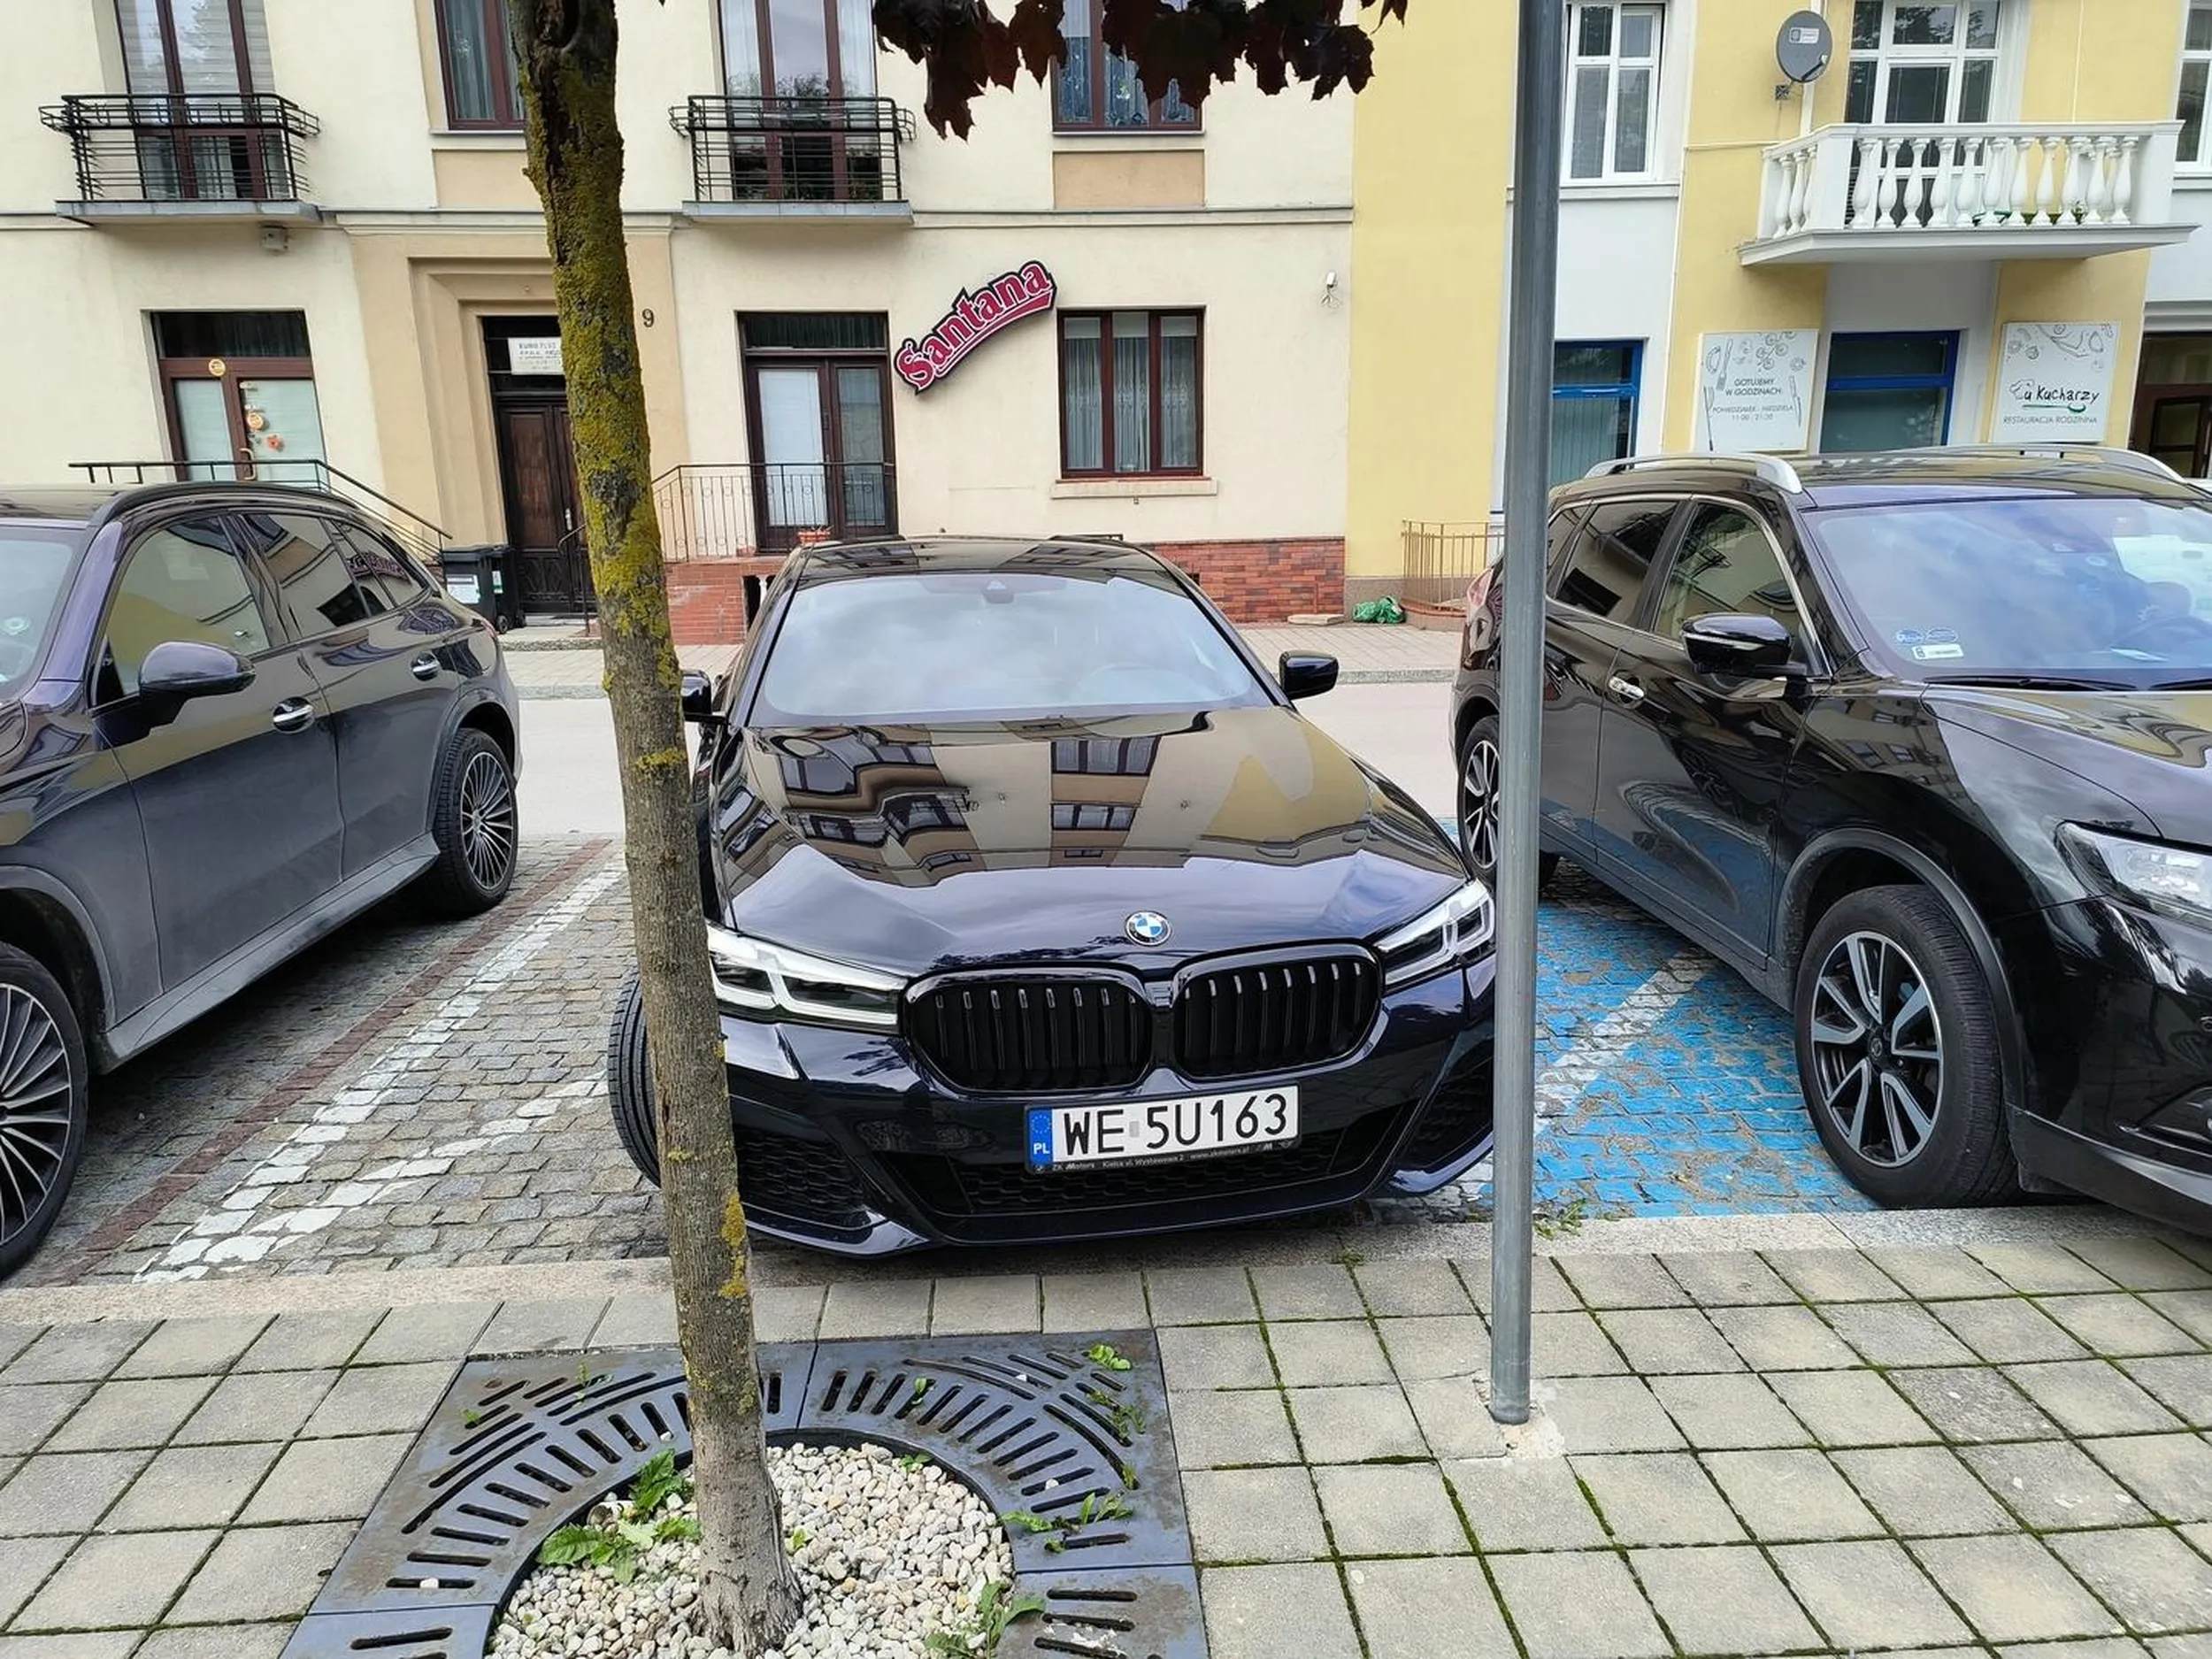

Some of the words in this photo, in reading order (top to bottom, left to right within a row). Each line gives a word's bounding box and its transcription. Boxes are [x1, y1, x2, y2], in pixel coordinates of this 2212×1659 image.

[641, 308, 655, 328] 9
[895, 262, 1055, 392] Santana
[1733, 378, 1775, 387] GOTUJEMY
[1734, 387, 1782, 396] GODZINACH
[2036, 385, 2100, 404] Kucharzy
[2003, 415, 2053, 425] RESTAURACJA
[2055, 415, 2098, 424] RODZINNA
[1064, 1109, 1125, 1156] WE
[1147, 1094, 1286, 1150] 5U163
[1033, 1142, 1050, 1155] PL
